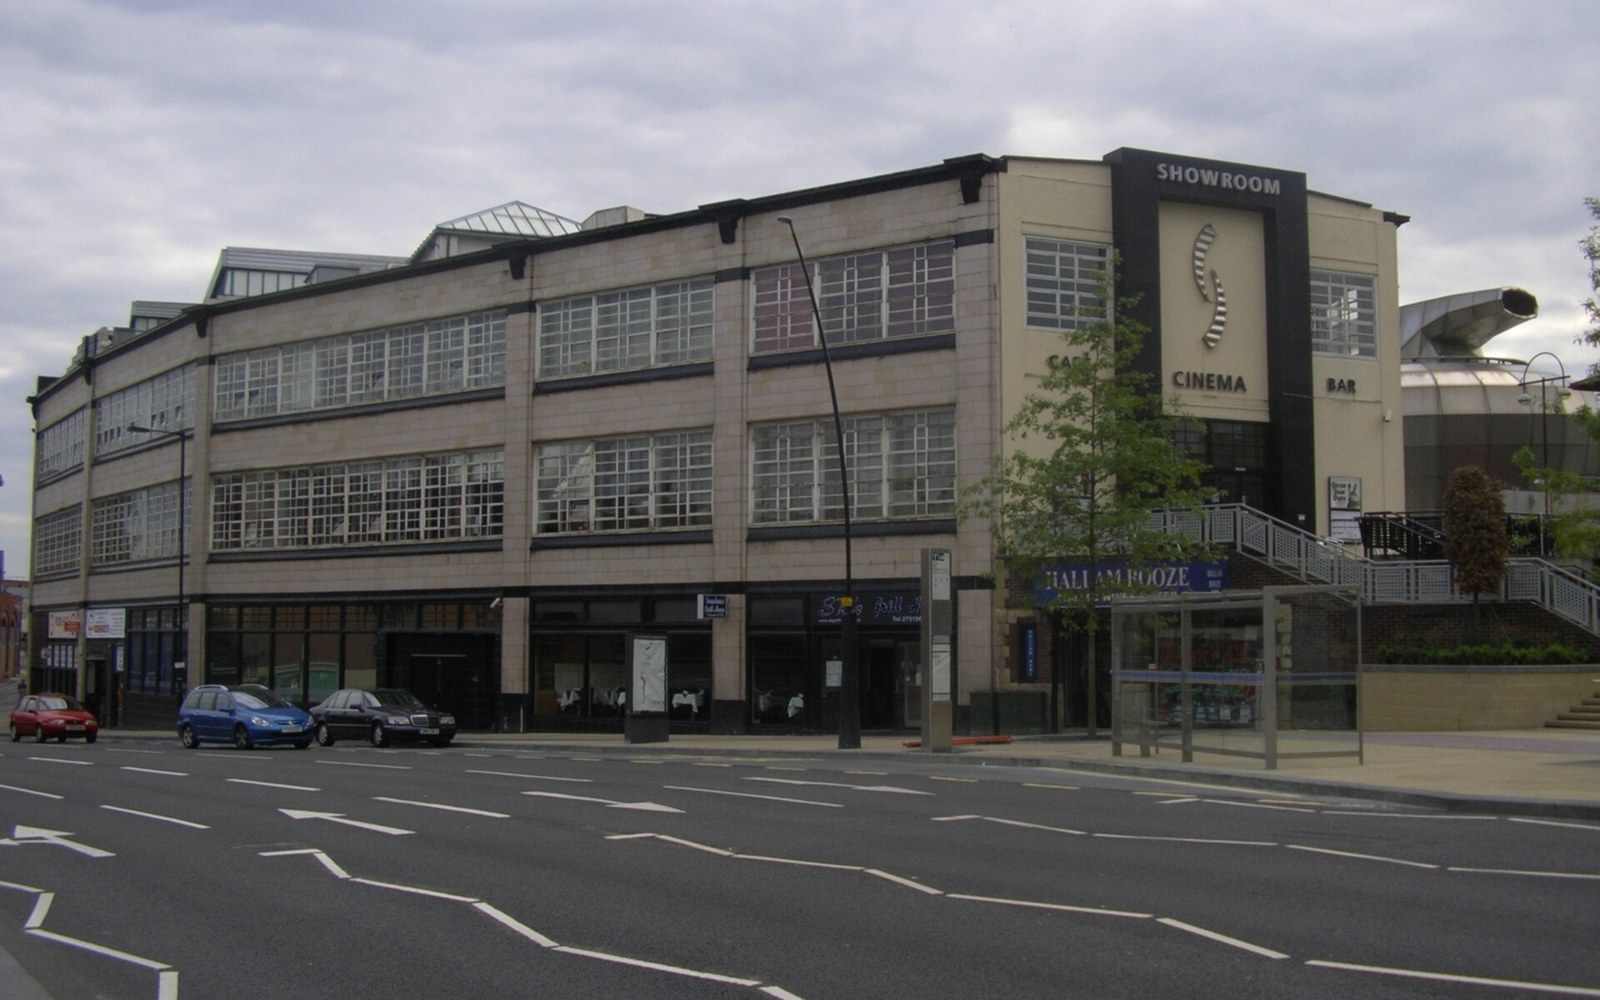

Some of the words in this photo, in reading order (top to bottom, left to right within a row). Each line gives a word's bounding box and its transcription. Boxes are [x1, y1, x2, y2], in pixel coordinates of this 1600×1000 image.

[1157, 163, 1281, 196] SHOWROOM
[1172, 370, 1247, 393] CINEMA
[1326, 377, 1356, 394] BAR
